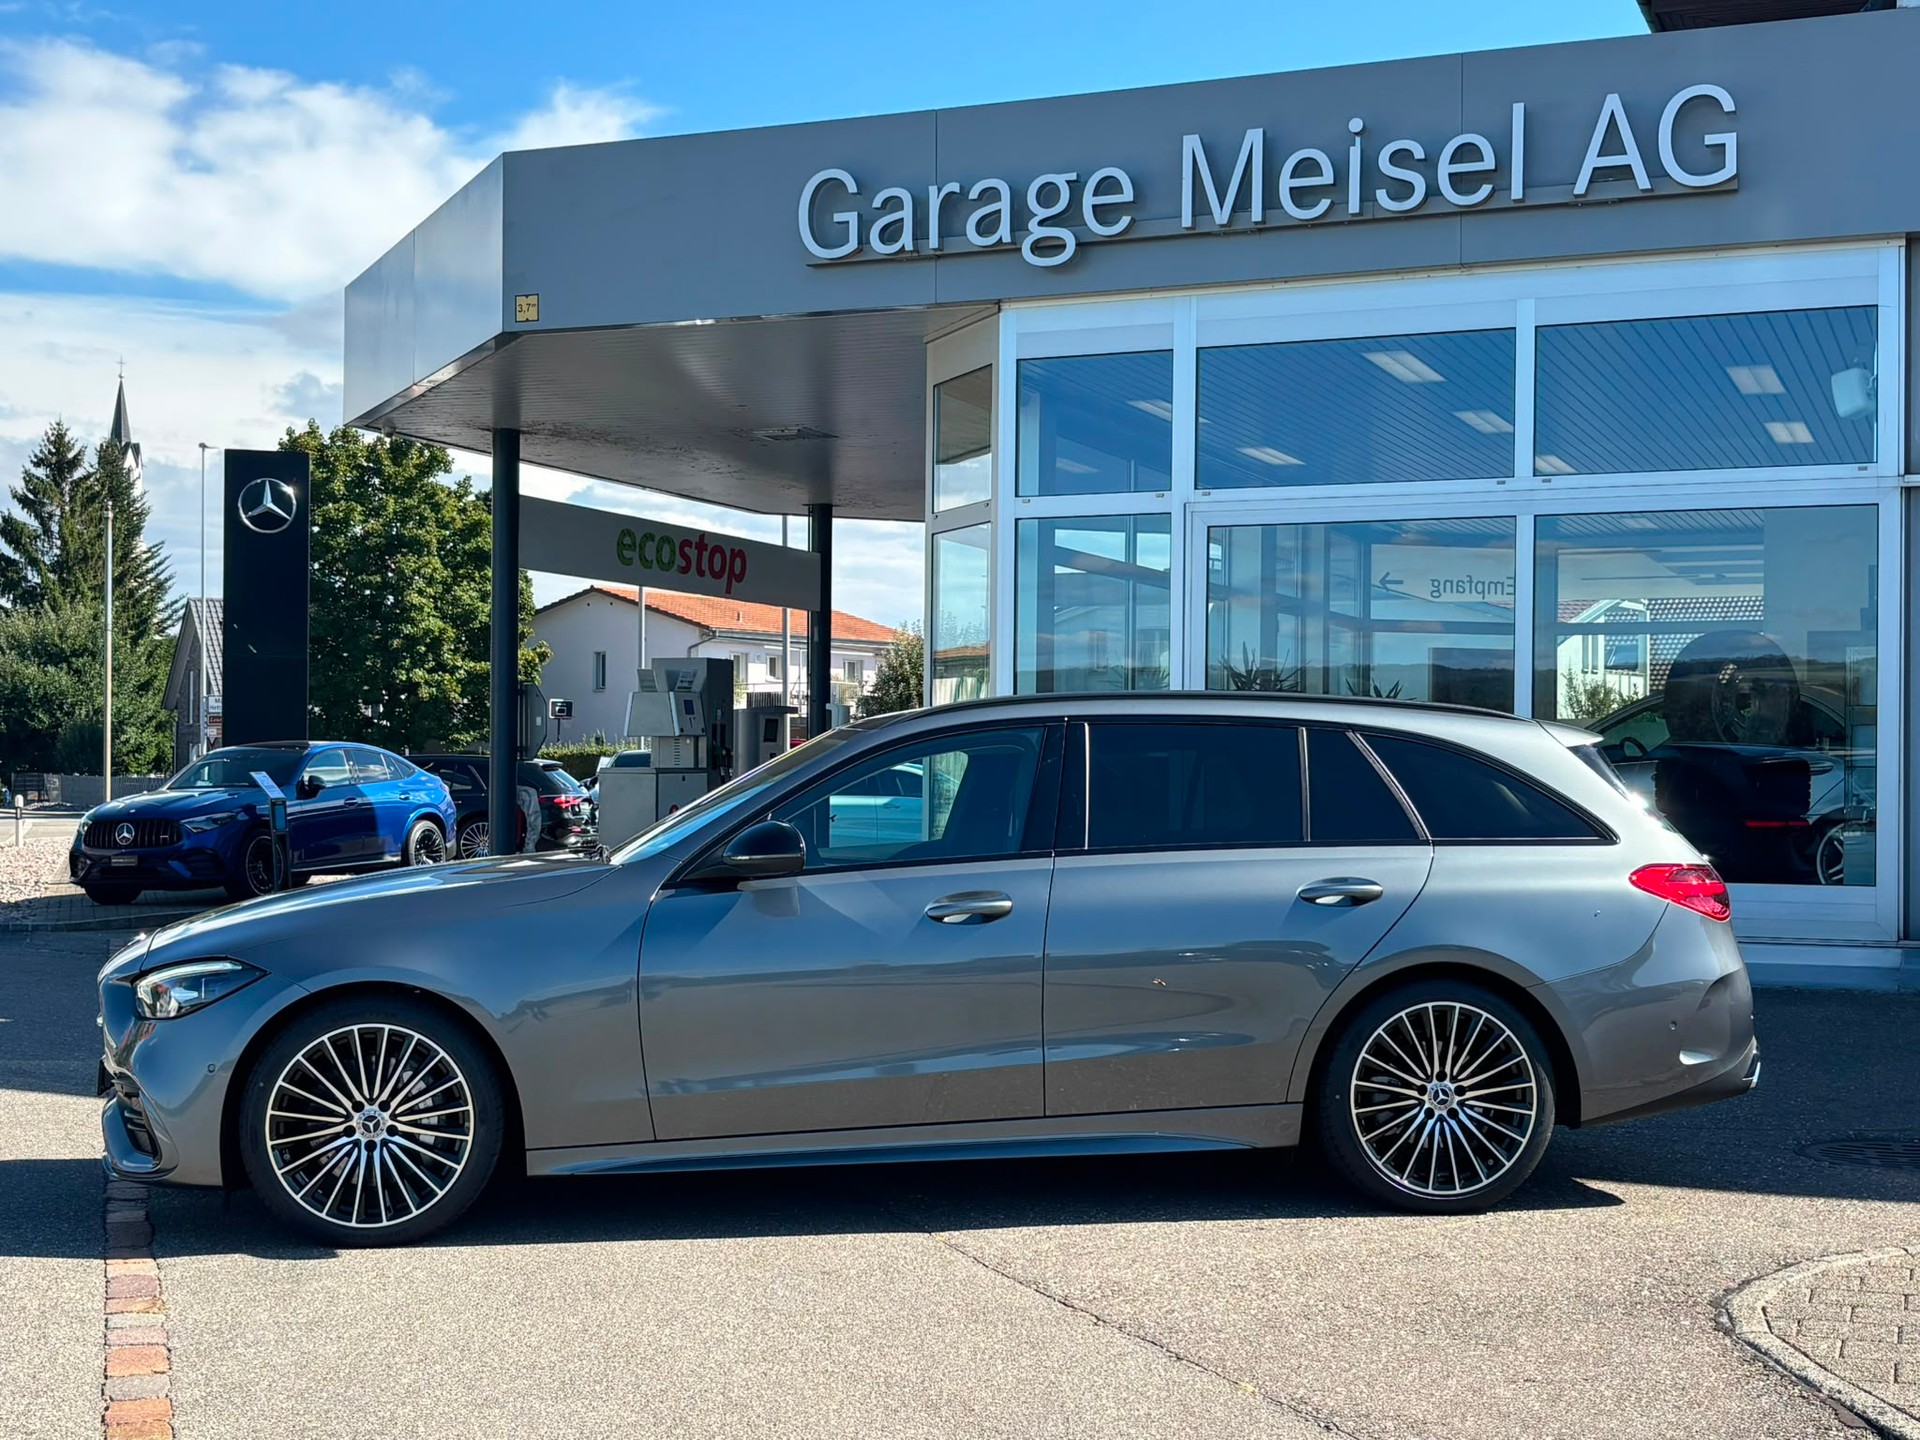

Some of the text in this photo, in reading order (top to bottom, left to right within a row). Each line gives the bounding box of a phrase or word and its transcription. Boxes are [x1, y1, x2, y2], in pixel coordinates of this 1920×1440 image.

[798, 84, 1738, 267] Garage Meisel AG
[616, 527, 747, 595] ecostop
